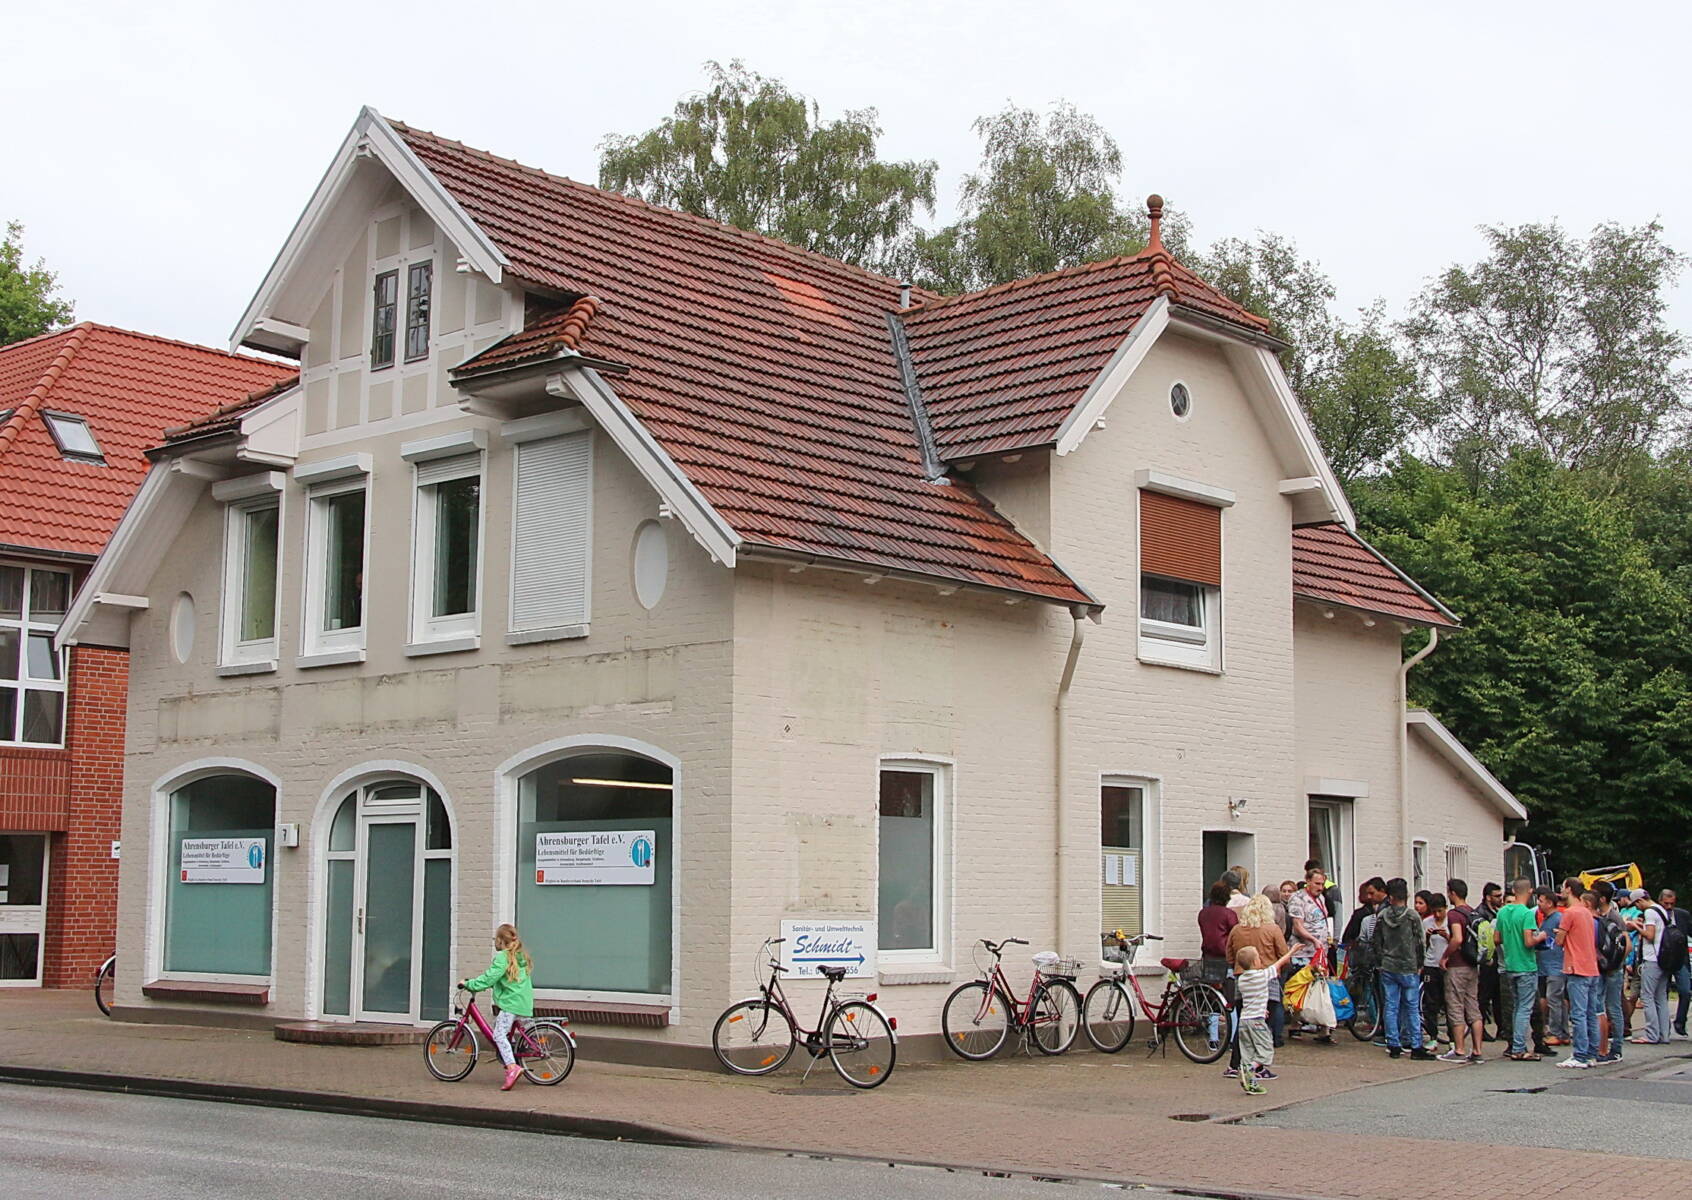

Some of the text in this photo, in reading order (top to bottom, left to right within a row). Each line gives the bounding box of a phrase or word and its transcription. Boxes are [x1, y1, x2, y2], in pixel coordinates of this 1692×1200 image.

[538, 834, 626, 847] Ahrensburger Tafel e.V.
[183, 841, 219, 851] Ahrensburger
[220, 841, 234, 850] Tafel
[537, 848, 605, 857] Lebensmittel für Bedürftige
[793, 935, 853, 953] Schmidt
[798, 966, 813, 975] Tel.:
